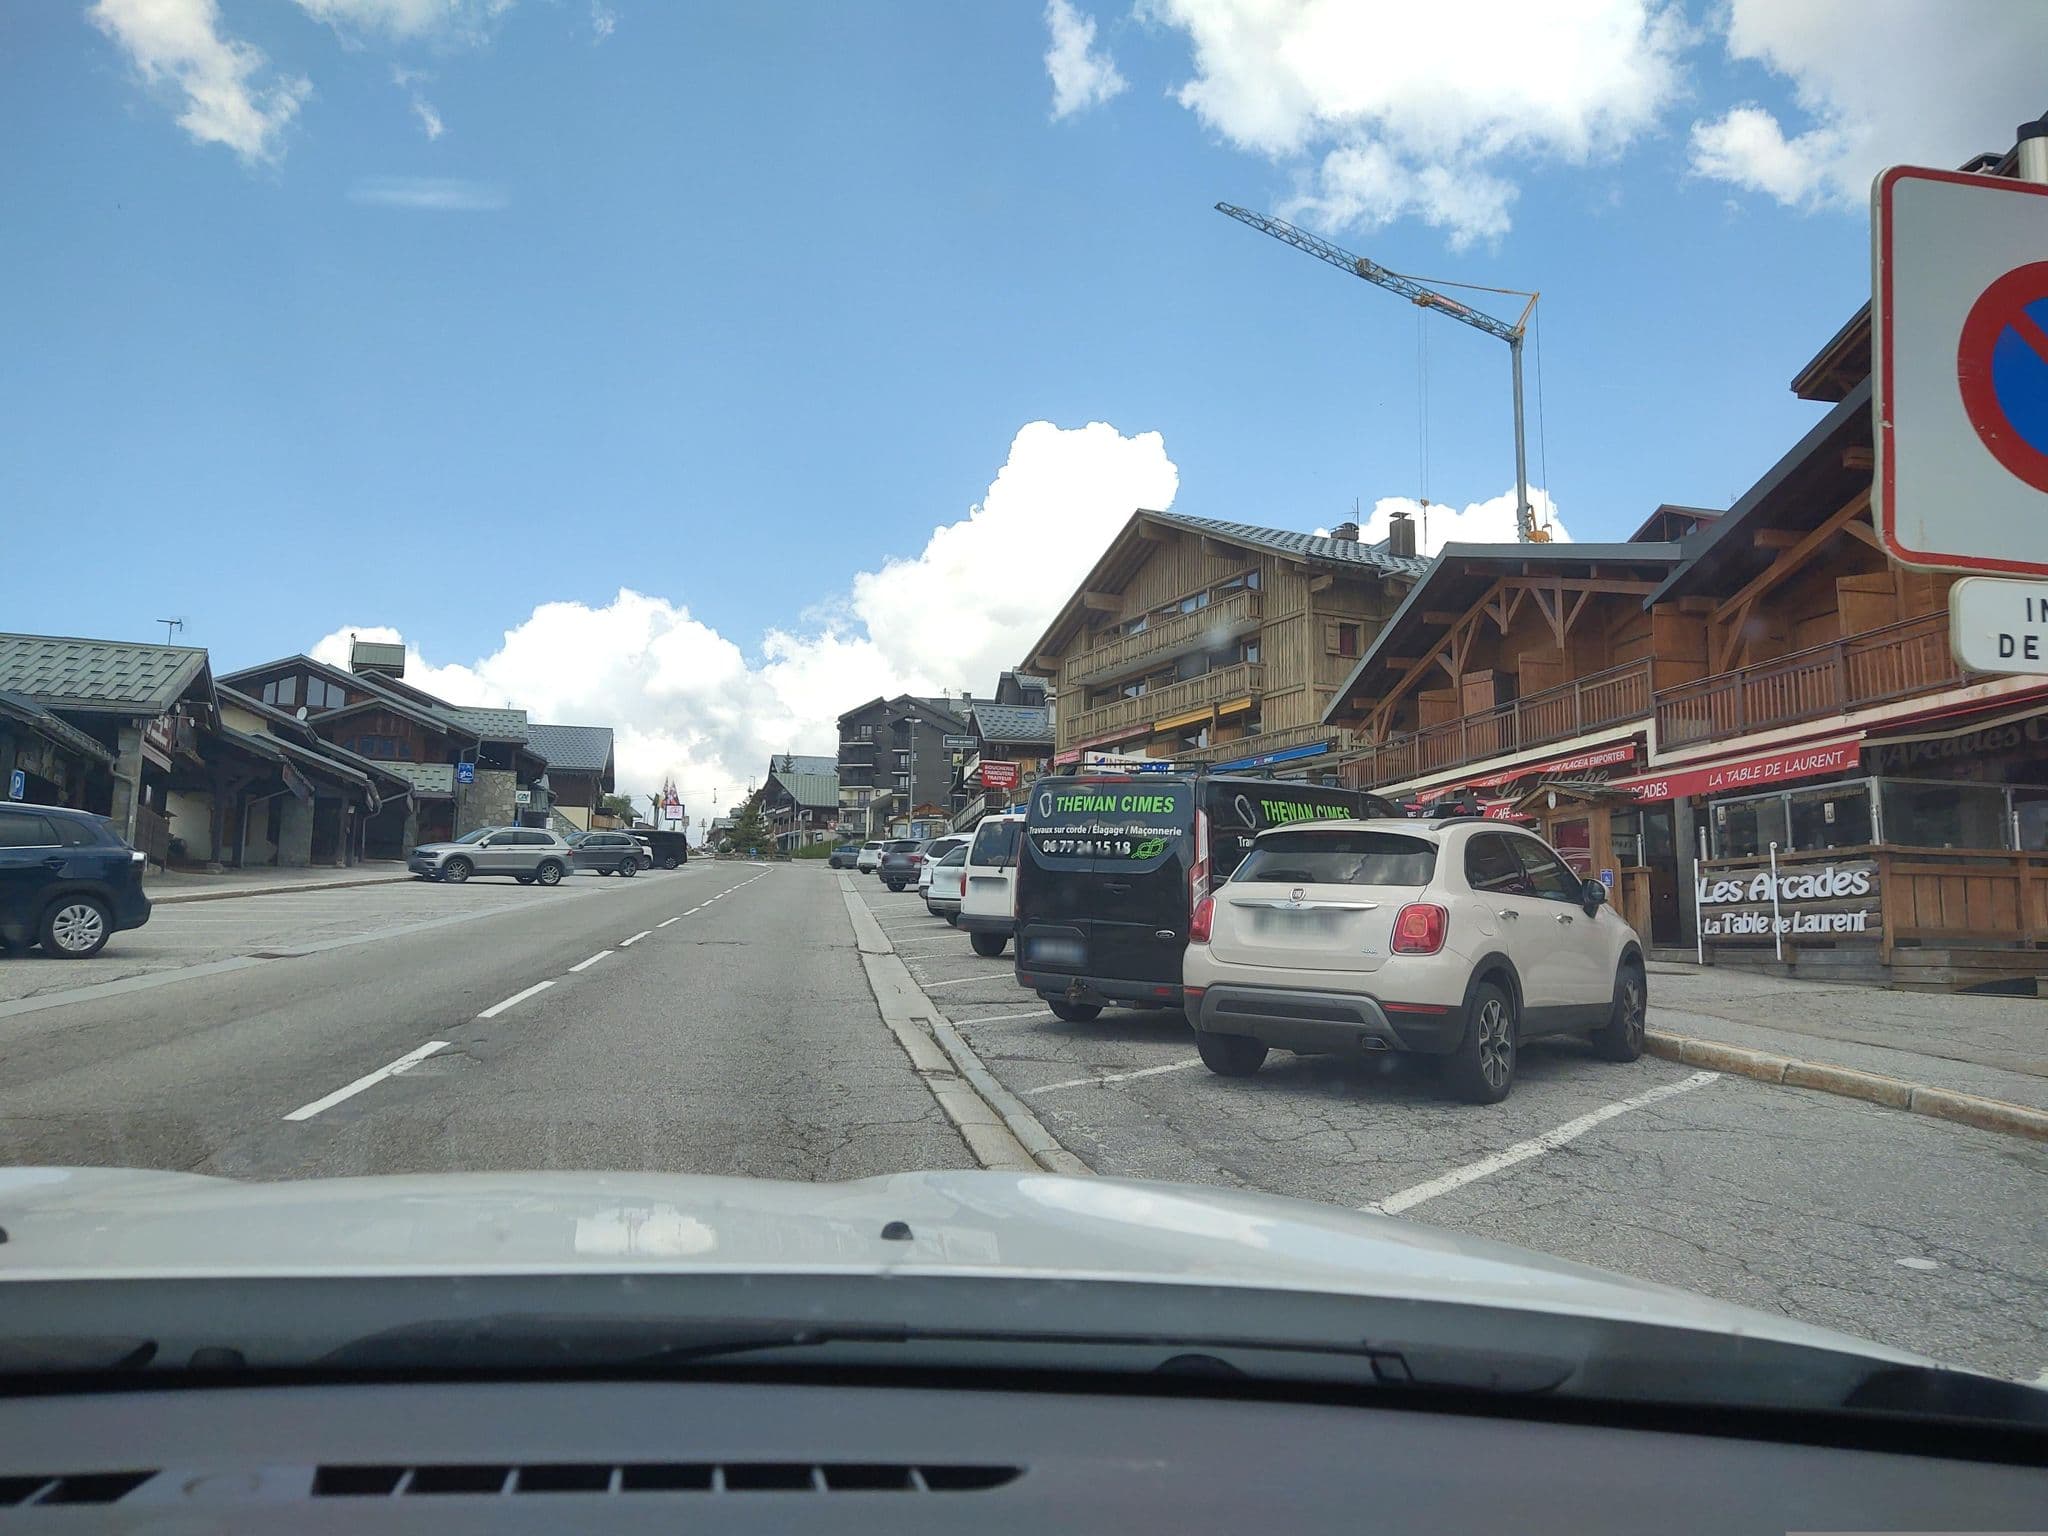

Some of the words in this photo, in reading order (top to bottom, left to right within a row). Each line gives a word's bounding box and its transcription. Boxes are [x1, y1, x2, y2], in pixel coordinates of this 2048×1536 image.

[1999, 633, 2039, 660] DE
[1589, 750, 1625, 766] EMPORTER
[1708, 774, 1723, 787] LA
[1726, 765, 1762, 782] TABLE
[1765, 762, 1781, 777] DE
[1785, 751, 1844, 773] LAURENT
[1056, 796, 1116, 812] THEWAN
[1121, 795, 1175, 813] CIMES
[1261, 800, 1314, 821] THEWAN
[1316, 804, 1352, 820] CIMES
[1029, 826, 1053, 835] Travaux
[1066, 825, 1086, 834] corde
[1092, 824, 1124, 836] Élagage
[1130, 825, 1182, 836] Maçonnerie
[1043, 840, 1057, 853] 06
[1060, 840, 1075, 853] 77
[1699, 877, 1744, 903] Les
[1749, 867, 1871, 901] Arcades
[1704, 918, 1721, 934] La
[1721, 911, 1769, 934] Table
[1772, 916, 1791, 933] de
[1792, 910, 1868, 933] Laurent
